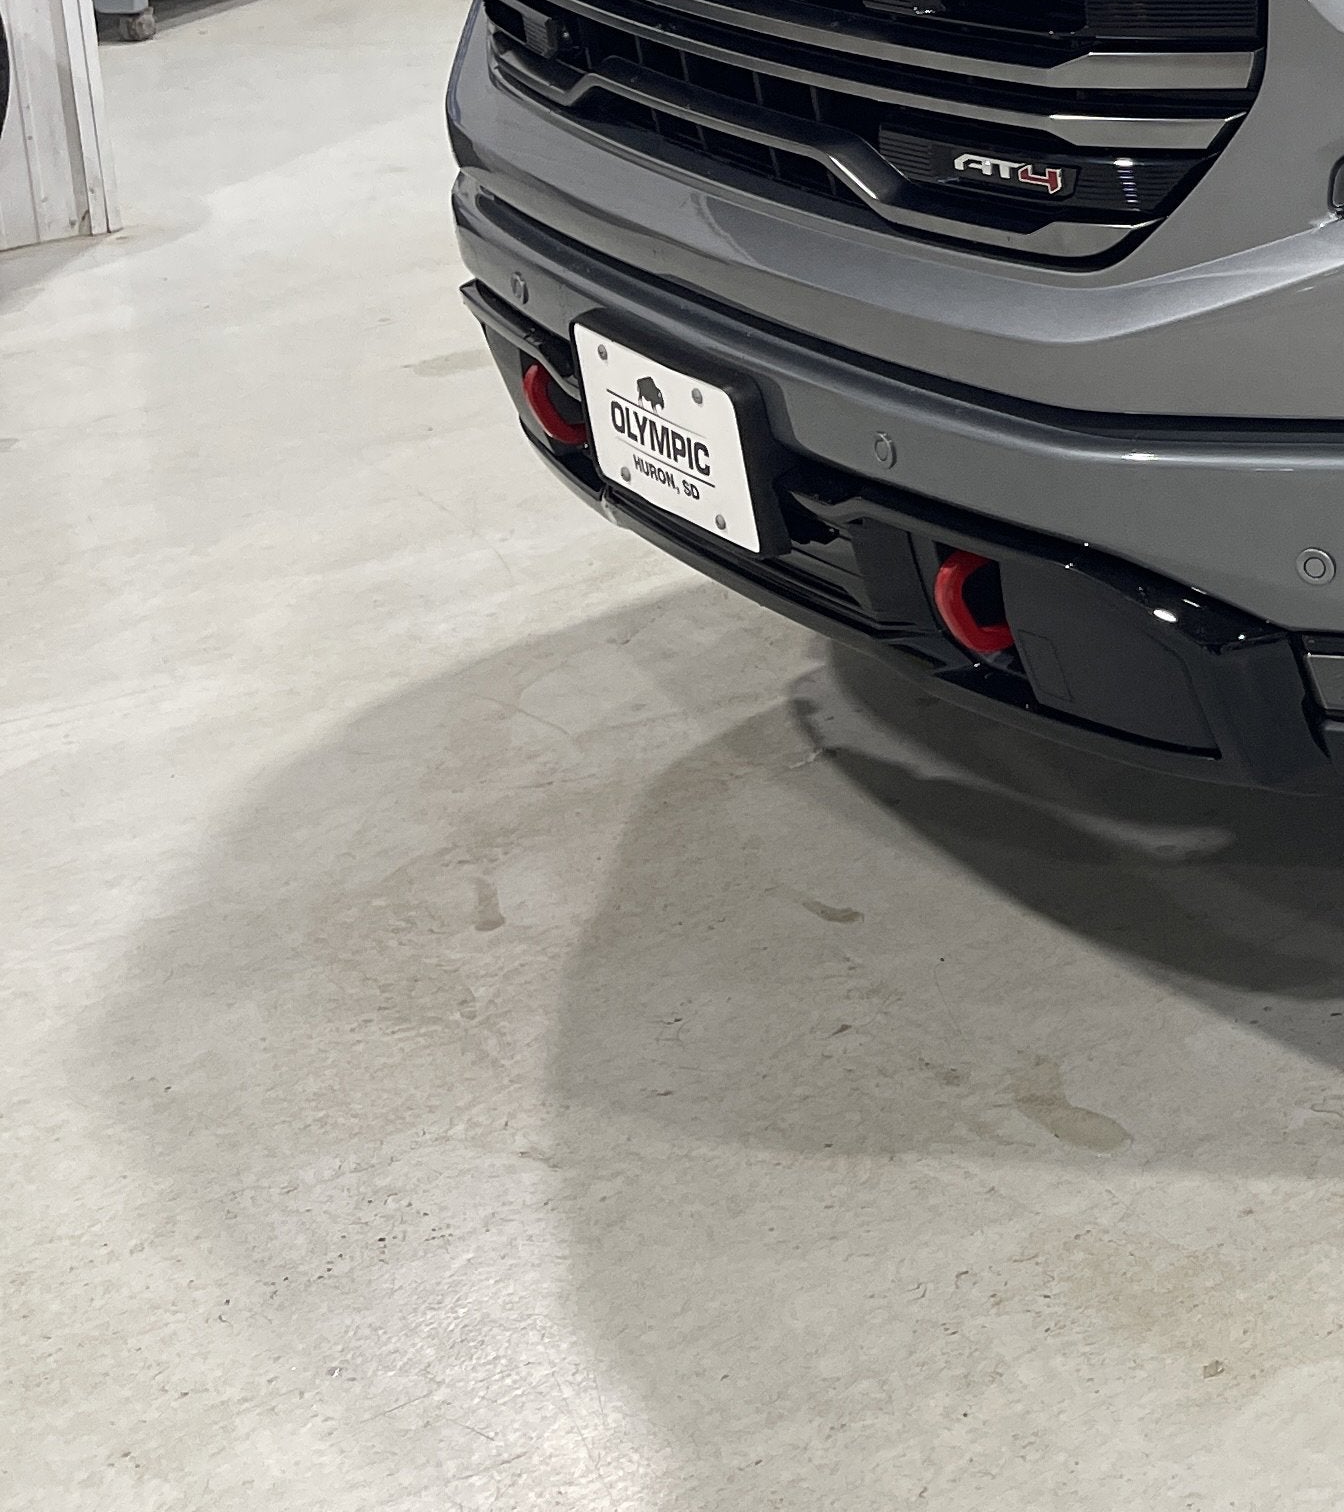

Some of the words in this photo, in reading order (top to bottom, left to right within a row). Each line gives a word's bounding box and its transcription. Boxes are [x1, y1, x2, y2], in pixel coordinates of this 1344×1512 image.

[954, 153, 1062, 194] AT4
[610, 400, 711, 477] OLYMPIC
[633, 454, 681, 494] HURON,
[682, 479, 700, 500] SD
